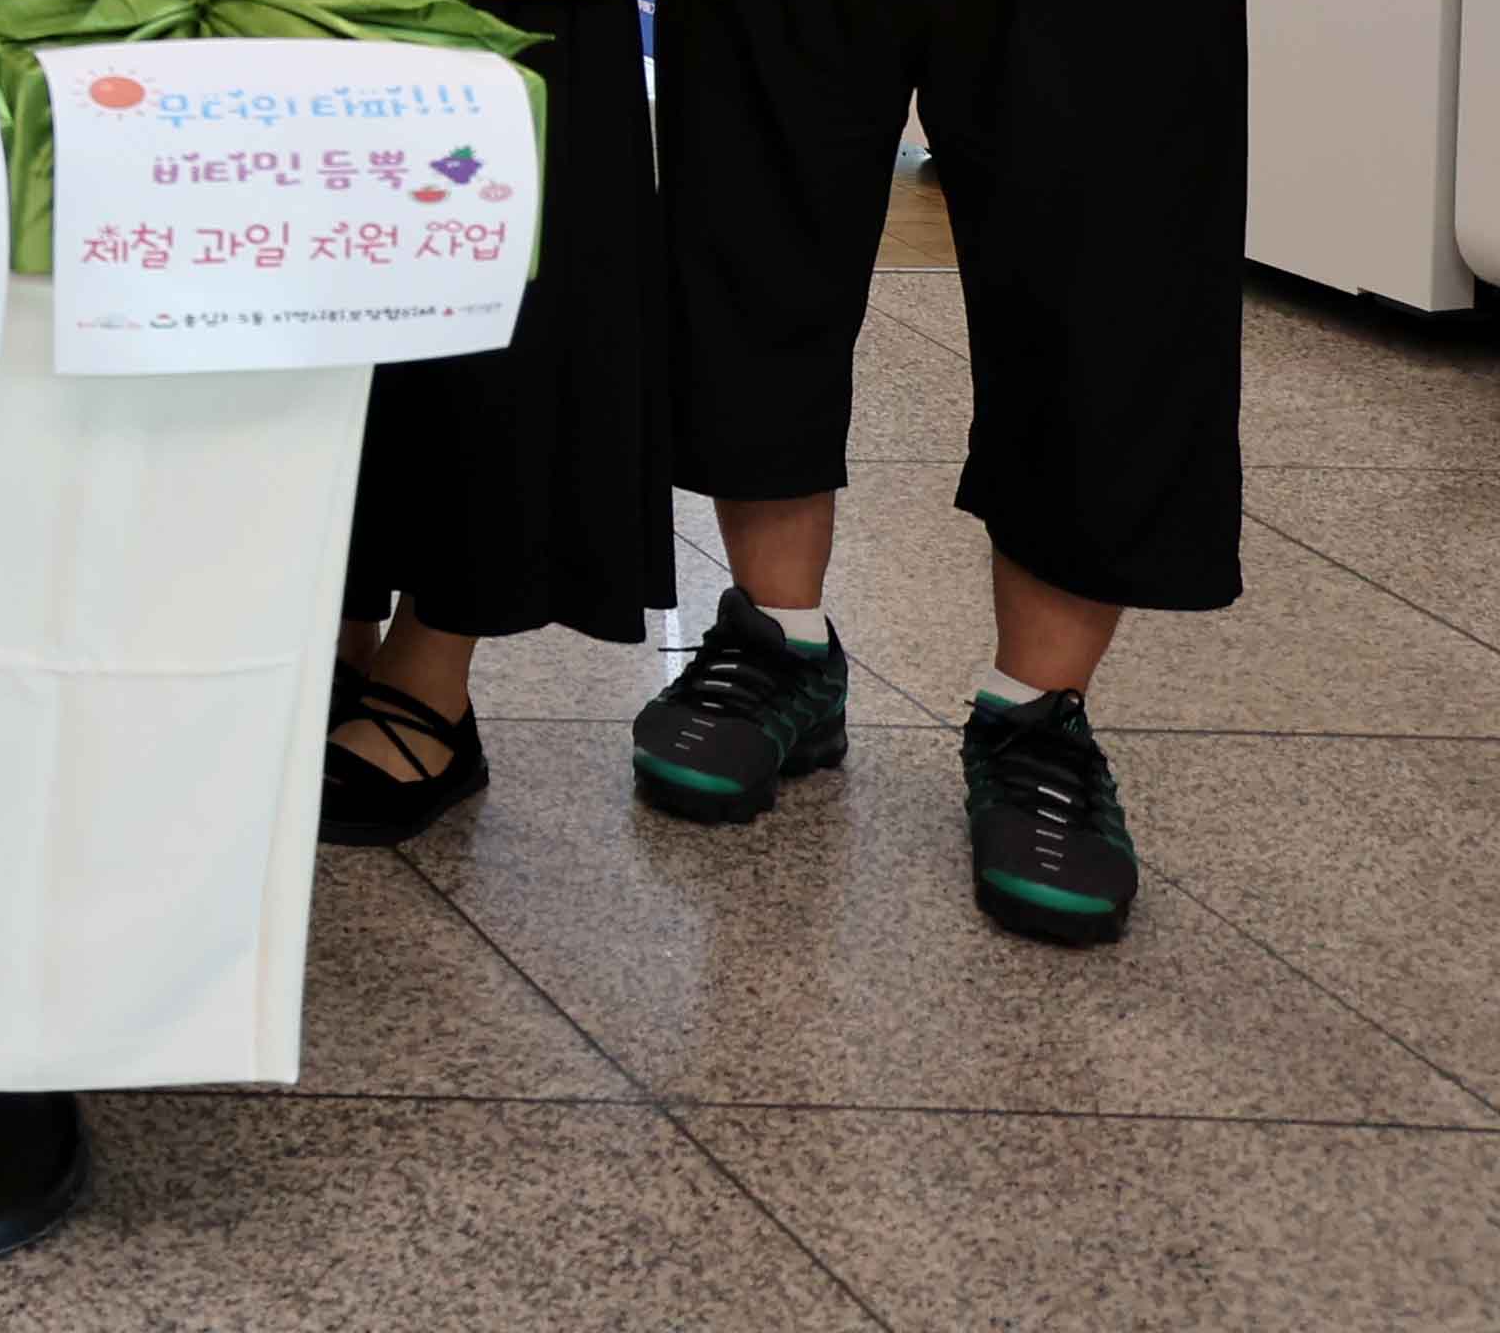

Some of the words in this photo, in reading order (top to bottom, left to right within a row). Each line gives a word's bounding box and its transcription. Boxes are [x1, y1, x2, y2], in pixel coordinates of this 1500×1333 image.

[155, 89, 297, 129] 무더위
[310, 84, 483, 120] 타파!!!
[152, 151, 302, 187] 비타민
[81, 222, 175, 270] 제철
[192, 221, 291, 269] 과일
[308, 220, 400, 265] 지원
[414, 219, 508, 261] 사업
